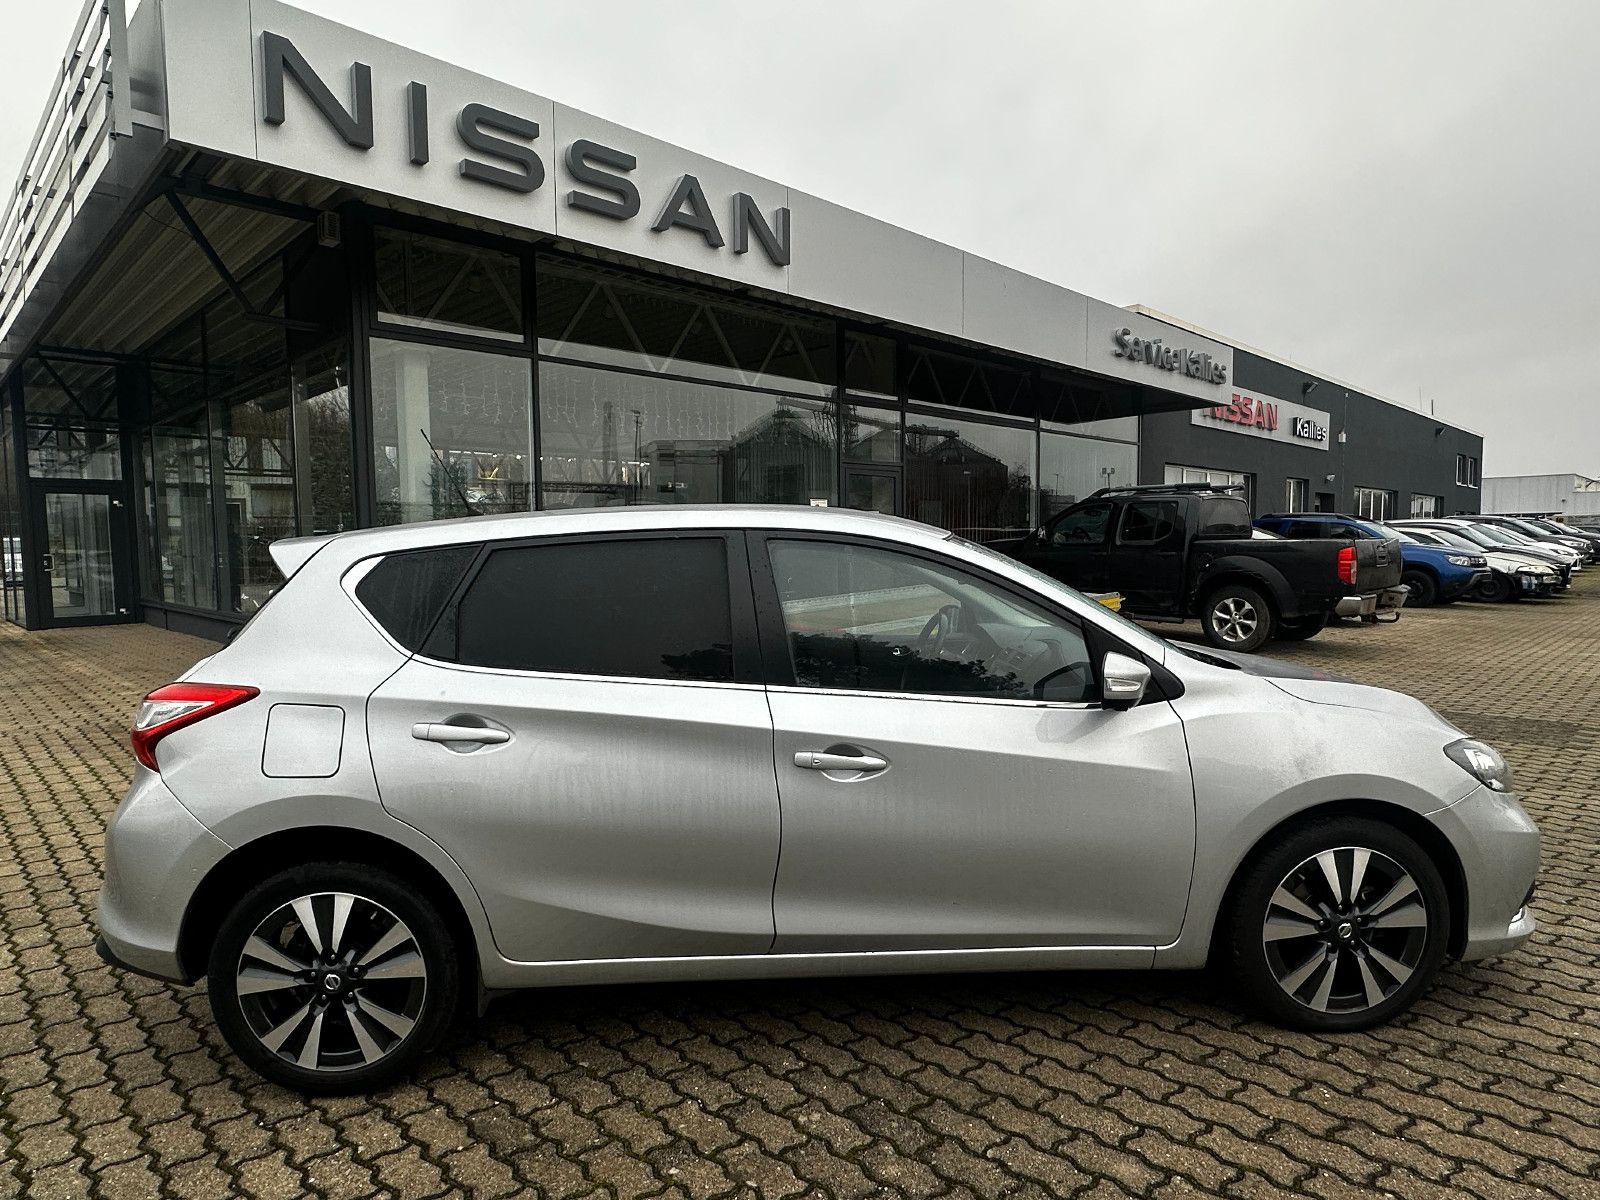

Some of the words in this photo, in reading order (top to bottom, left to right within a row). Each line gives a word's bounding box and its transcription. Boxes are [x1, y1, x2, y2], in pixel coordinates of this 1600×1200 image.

[260, 30, 790, 267] NISSAN
[1113, 328, 1179, 371] Service
[1179, 348, 1227, 385] Kallies
[1294, 417, 1327, 441] Kallies
